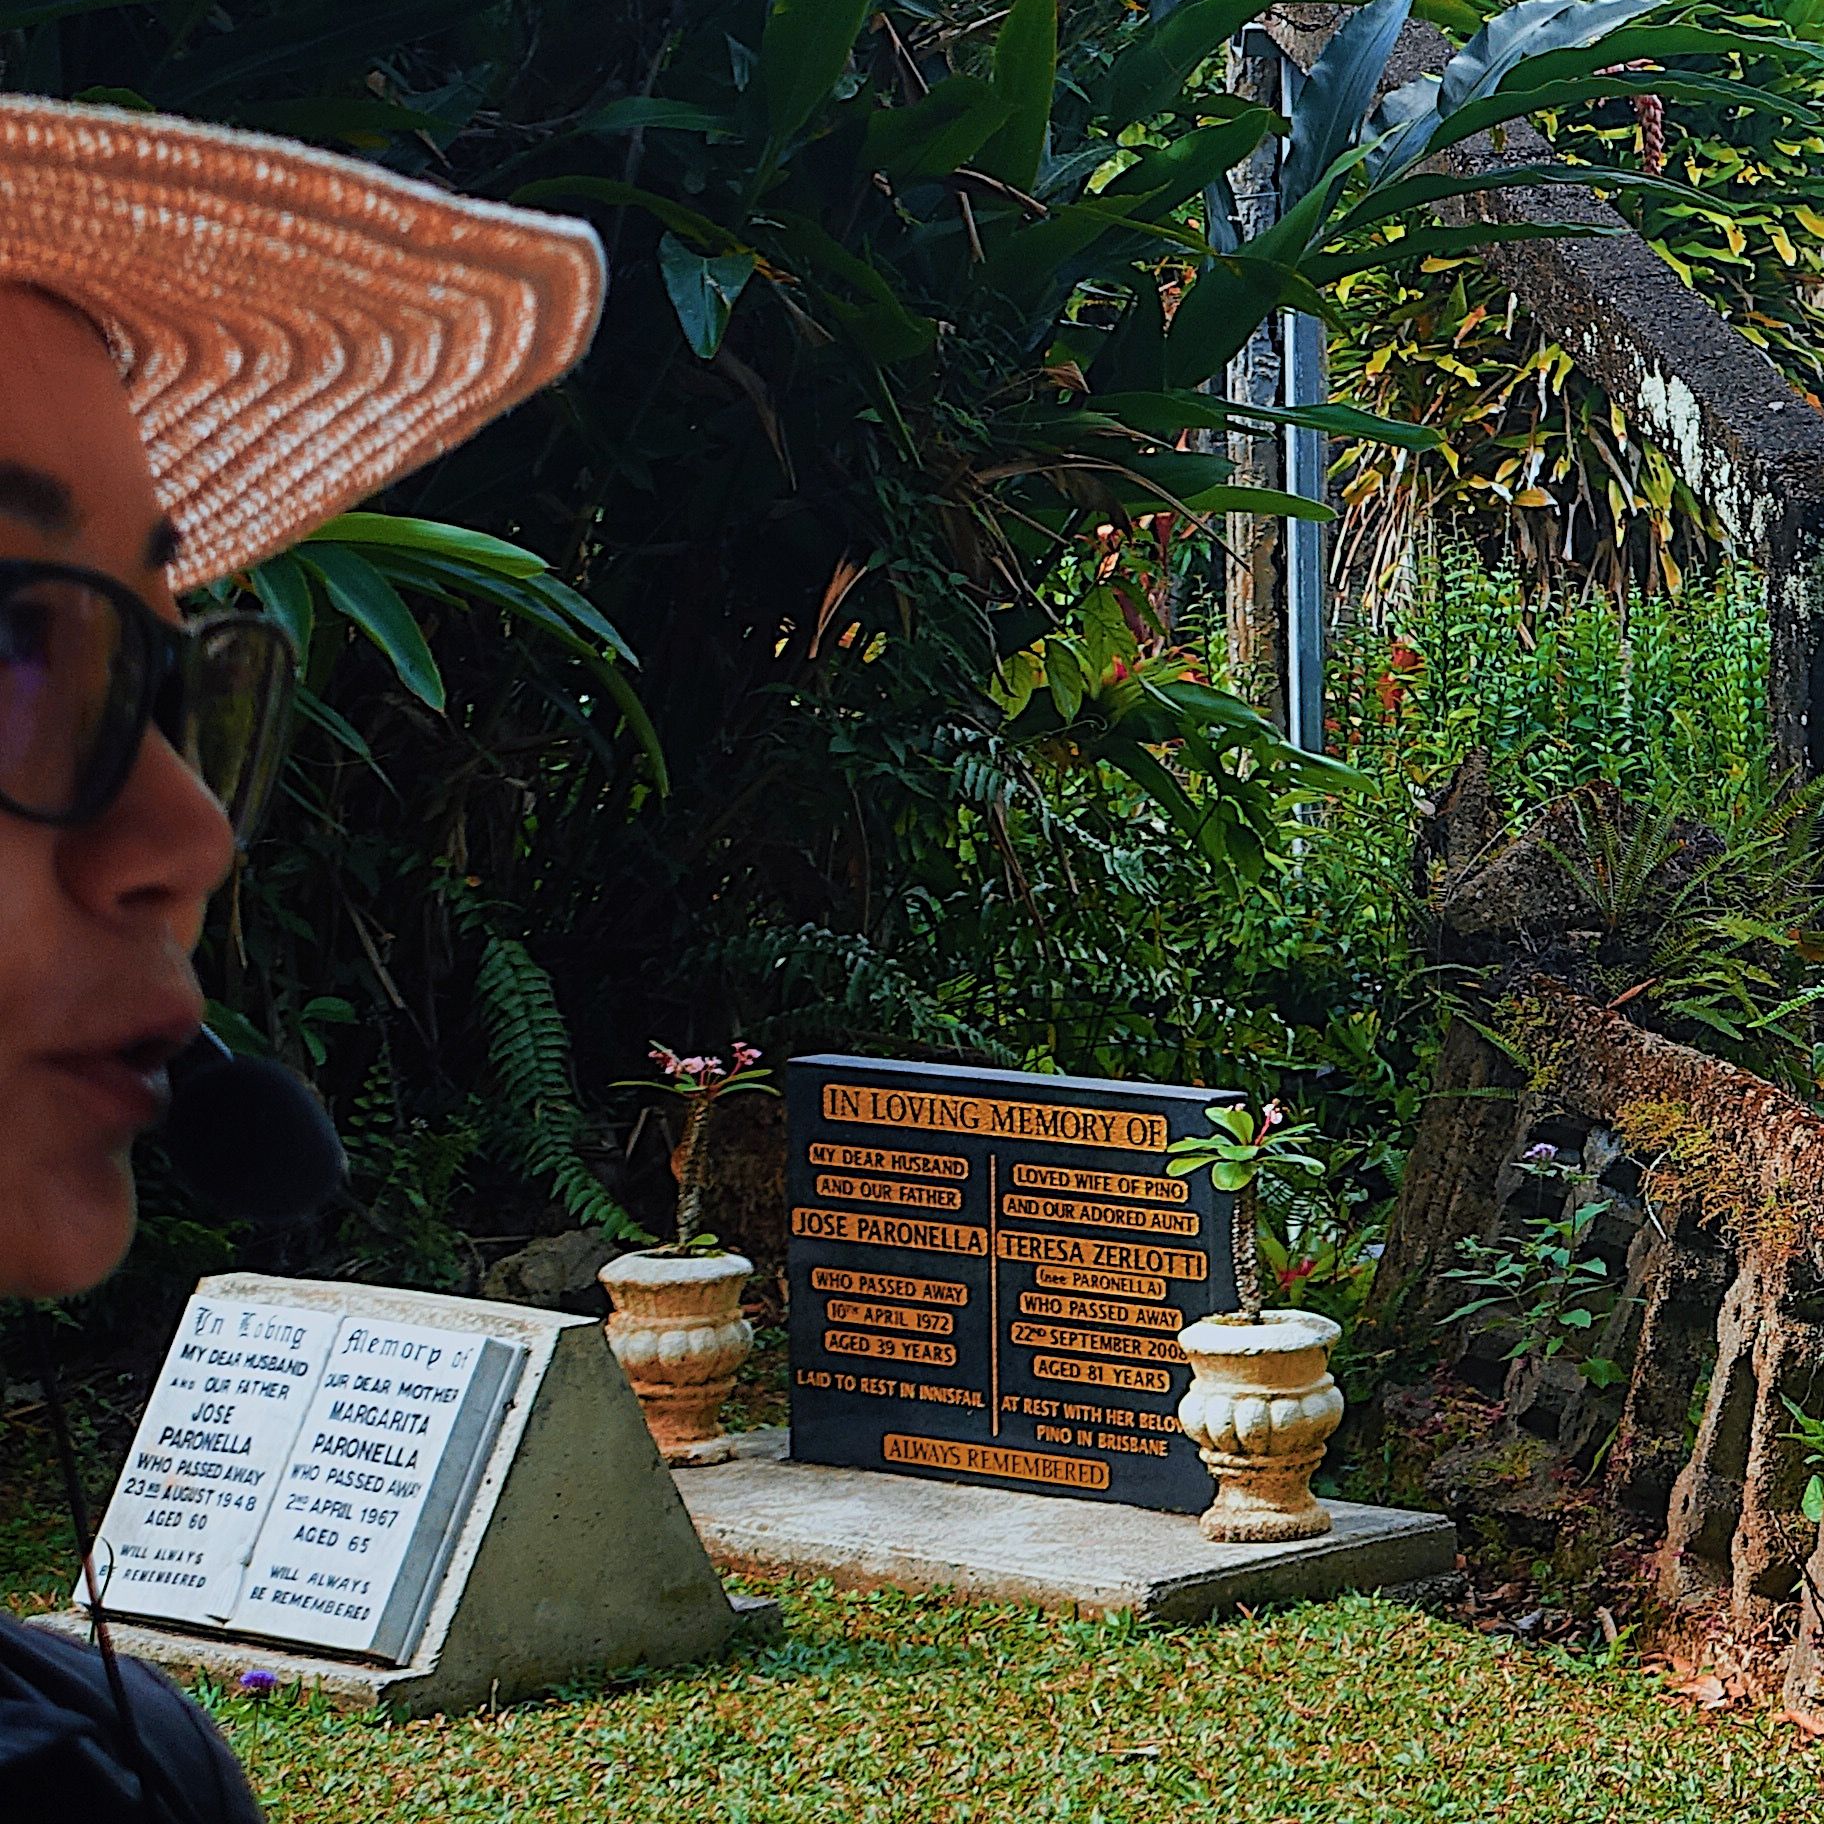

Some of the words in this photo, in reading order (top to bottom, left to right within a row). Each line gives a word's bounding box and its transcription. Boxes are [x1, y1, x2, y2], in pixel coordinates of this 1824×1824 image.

[829, 1088, 860, 1118] IN
[871, 1092, 979, 1129] LOVING
[990, 1104, 1116, 1142] MEMORY
[1126, 1118, 1162, 1147] OF
[813, 1146, 836, 1162] MY
[842, 1149, 885, 1168] DEAR
[892, 1155, 965, 1176] HUSBAND
[821, 1178, 854, 1195] AND
[860, 1182, 892, 1200] OUR
[900, 1186, 956, 1206] FATHER
[1017, 1167, 1070, 1187] LOVED
[1075, 1174, 1112, 1192] WIFE
[1118, 1178, 1140, 1196] OF
[1145, 1181, 1184, 1199] PINO
[1007, 1198, 1039, 1215] AND
[1043, 1202, 1074, 1218] OUR
[1080, 1205, 1146, 1226] ADORED
[1151, 1214, 1195, 1232] AUNT
[797, 1212, 848, 1238] JOSE
[858, 1218, 982, 1253] PARONELLA
[1001, 1234, 1084, 1264] TERESA
[1092, 1244, 1202, 1277] ZERLOTTI
[815, 1271, 853, 1289] WHO
[859, 1276, 917, 1297] PASSED
[922, 1283, 964, 1303] AWAY
[1040, 1268, 1066, 1286] (nee
[1073, 1273, 1162, 1295] PARONELLA)
[864, 1307, 909, 1327] APRIL
[917, 1313, 950, 1332] 1972
[1024, 1296, 1062, 1315] WHO
[1070, 1301, 1129, 1322] PASSED
[1136, 1309, 1178, 1327] AWAY
[829, 1334, 870, 1353] AGED
[877, 1339, 895, 1356] 39
[902, 1344, 953, 1364] YEARS
[1015, 1325, 1047, 1342] 22ND
[1050, 1329, 1142, 1356] SEPTEMBER
[180, 1343, 209, 1362] MY
[208, 1348, 243, 1367] DEAR
[245, 1352, 309, 1377] HUSBAND
[1038, 1359, 1081, 1379] AGED
[1088, 1365, 1103, 1377] 81
[1114, 1369, 1166, 1390] YEARS
[204, 1377, 231, 1393] OUR
[235, 1379, 290, 1400] FATHER
[324, 1374, 350, 1389] OUR
[353, 1374, 392, 1395] DEAR
[797, 1369, 831, 1388] LAID
[835, 1374, 856, 1392] TO
[860, 1377, 897, 1396] REST
[900, 1382, 916, 1399] IN
[919, 1384, 986, 1408] INNISFAIL
[191, 1402, 235, 1424] JOSE
[329, 1400, 431, 1436] MARGARITA
[1001, 1396, 1020, 1412] AT
[1023, 1398, 1060, 1419] REST
[1063, 1403, 1102, 1424] WITH
[1106, 1408, 1134, 1428] HER
[158, 1426, 252, 1456] PARONELLA
[311, 1433, 419, 1469] PARONELLA
[1036, 1425, 1072, 1444] PINO
[1077, 1429, 1093, 1448] IN
[1097, 1433, 1169, 1457] BRISBANE
[136, 1452, 173, 1475] WHO
[176, 1459, 223, 1480] PASSED
[223, 1465, 266, 1487] AWAY
[888, 1438, 961, 1466] ALWAYS
[967, 1448, 1105, 1486] REMEMBERED
[123, 1477, 161, 1499] 23RD
[161, 1484, 216, 1507] AUGUST
[216, 1492, 258, 1512] 1948
[290, 1463, 321, 1481] WHO
[325, 1468, 384, 1493] PASSED
[386, 1479, 422, 1499] AWAY
[144, 1509, 182, 1528] AGED
[188, 1512, 208, 1531] 60
[309, 1497, 353, 1521] APRIL
[360, 1507, 400, 1529] 1967
[120, 1544, 148, 1559] WILL
[153, 1548, 204, 1565] ALWAYS
[293, 1525, 339, 1547] AGED
[348, 1535, 371, 1554] 65
[122, 1568, 207, 1588] REMEMBERED
[269, 1565, 299, 1582] WILL
[307, 1572, 371, 1595] ALWAYS
[249, 1586, 267, 1600] BE
[271, 1590, 371, 1621] REMEMBERED
